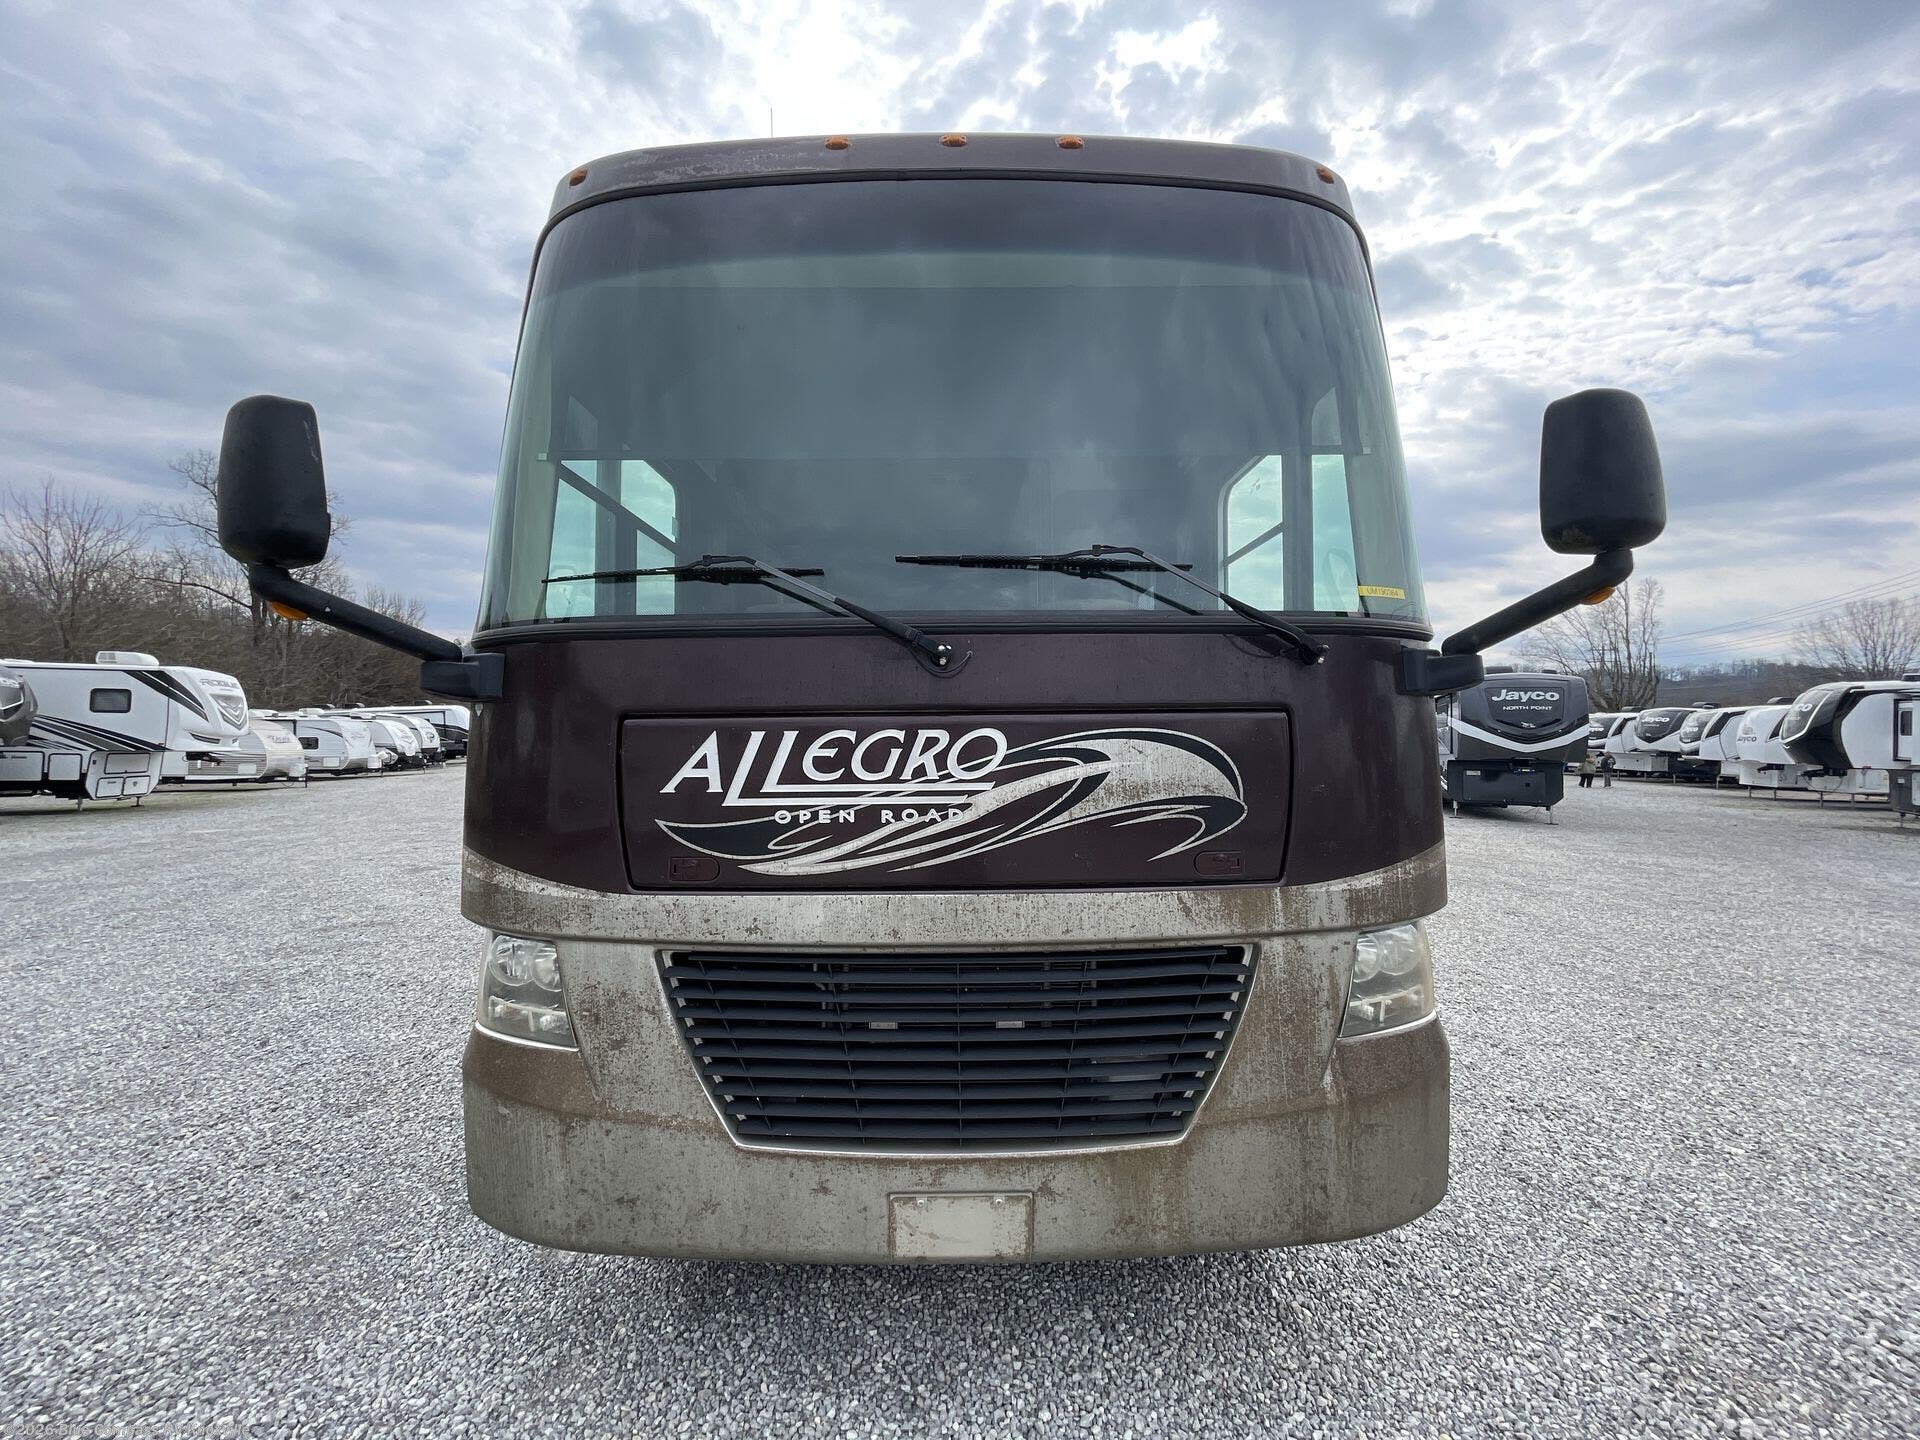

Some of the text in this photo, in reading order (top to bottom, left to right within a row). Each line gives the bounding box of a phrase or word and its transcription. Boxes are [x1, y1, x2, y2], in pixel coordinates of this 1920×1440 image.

[1491, 689, 1560, 703] Jayco
[659, 728, 1008, 807] ALLEGRO
[774, 808, 964, 825] OPEN ROAD
